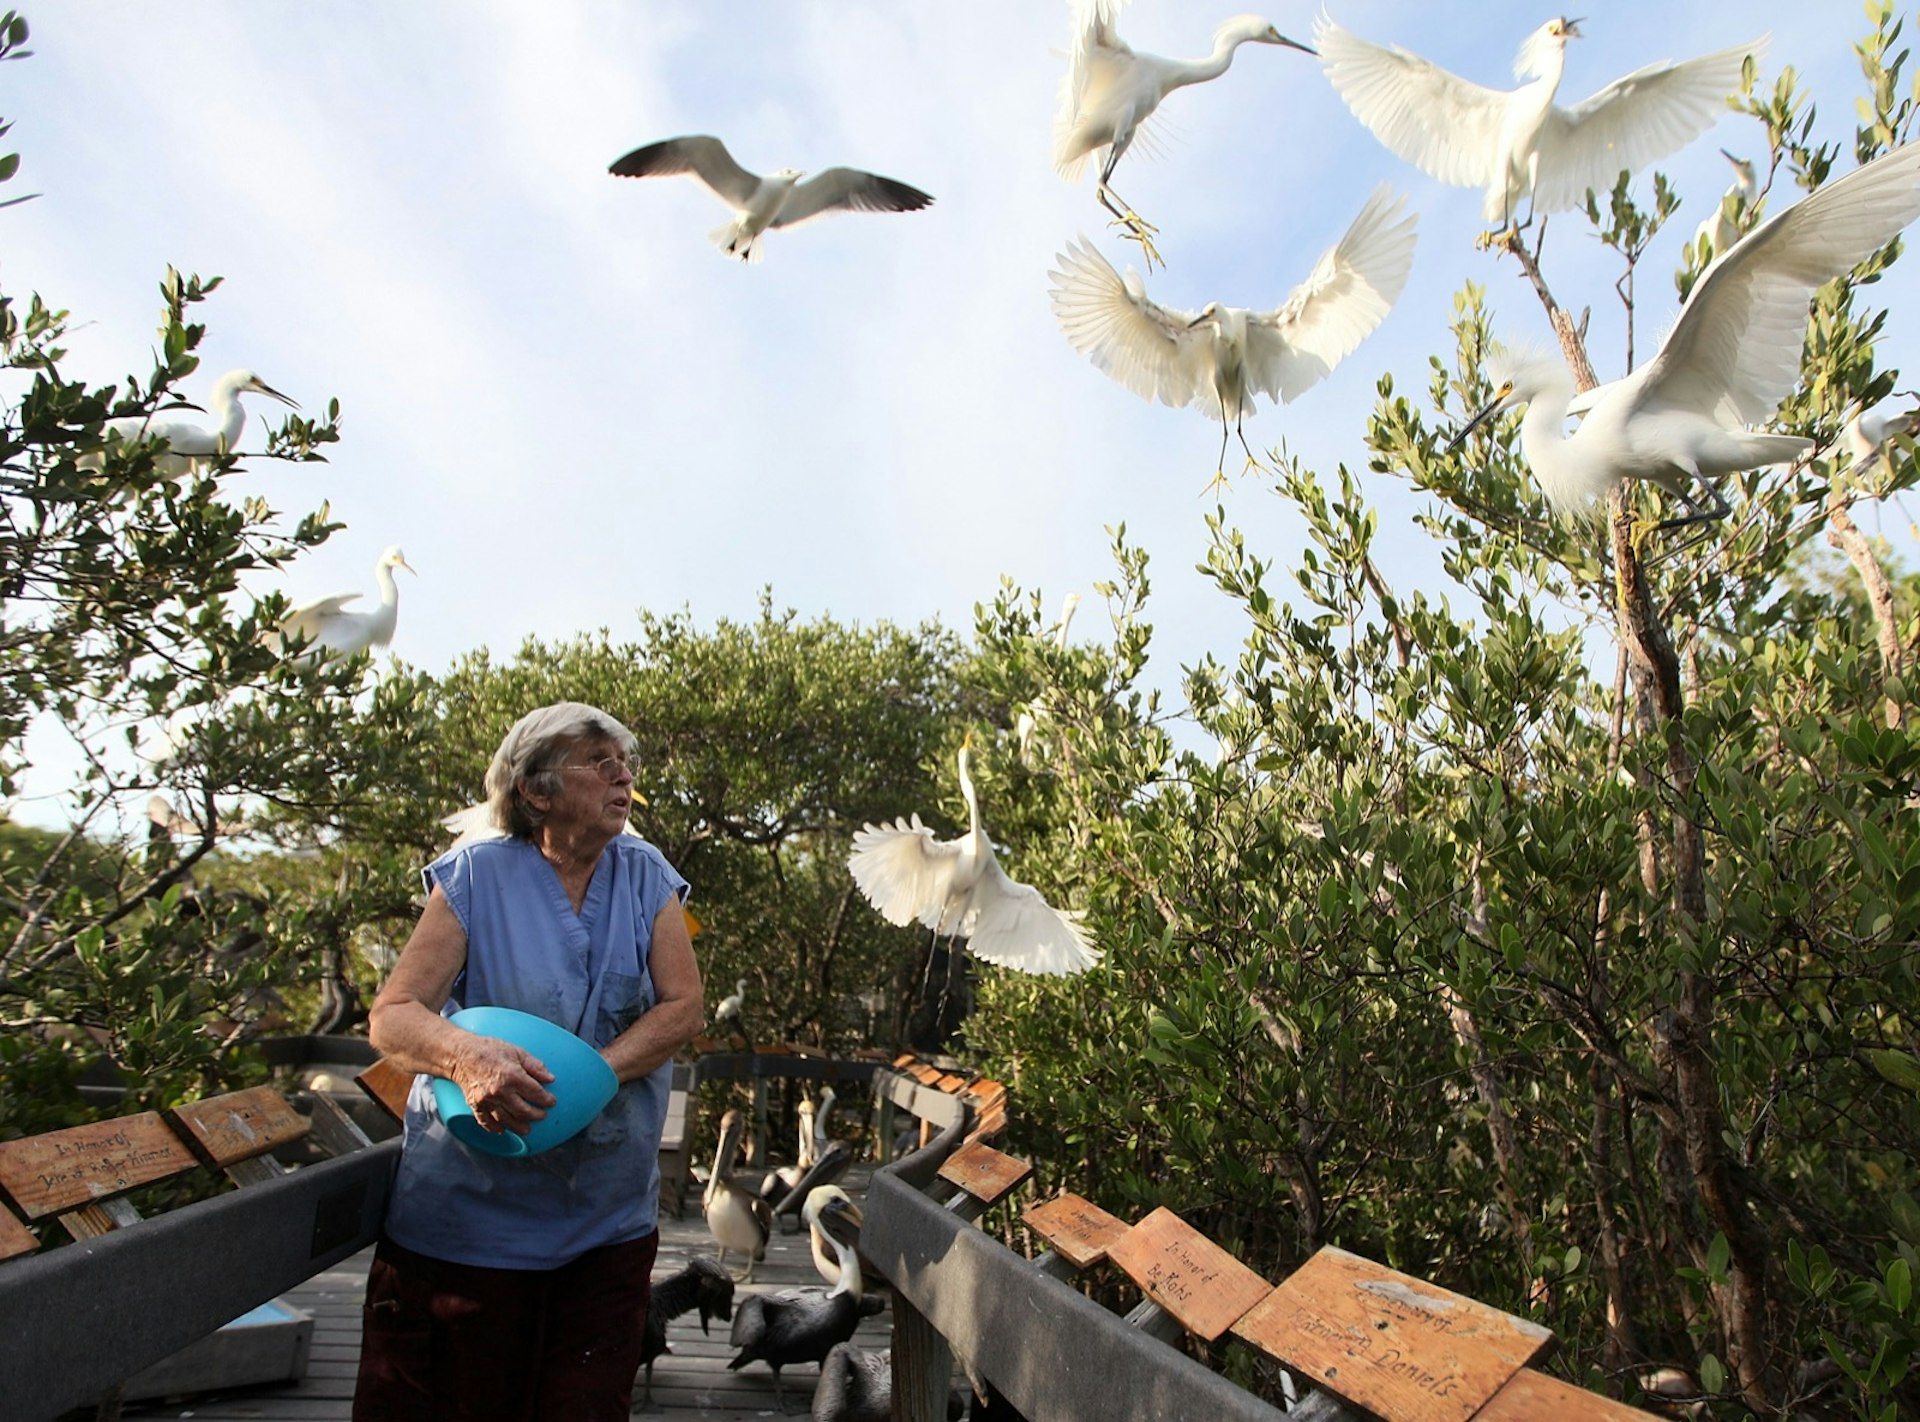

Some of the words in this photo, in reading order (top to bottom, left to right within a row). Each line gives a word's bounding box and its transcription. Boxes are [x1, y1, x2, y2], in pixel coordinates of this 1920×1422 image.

[54, 1143, 71, 1156] In
[1165, 1241, 1179, 1255] In
[1178, 1250, 1204, 1274] Honor
[1201, 1272, 1219, 1286] of
[1375, 1349, 1458, 1396] Daniels
